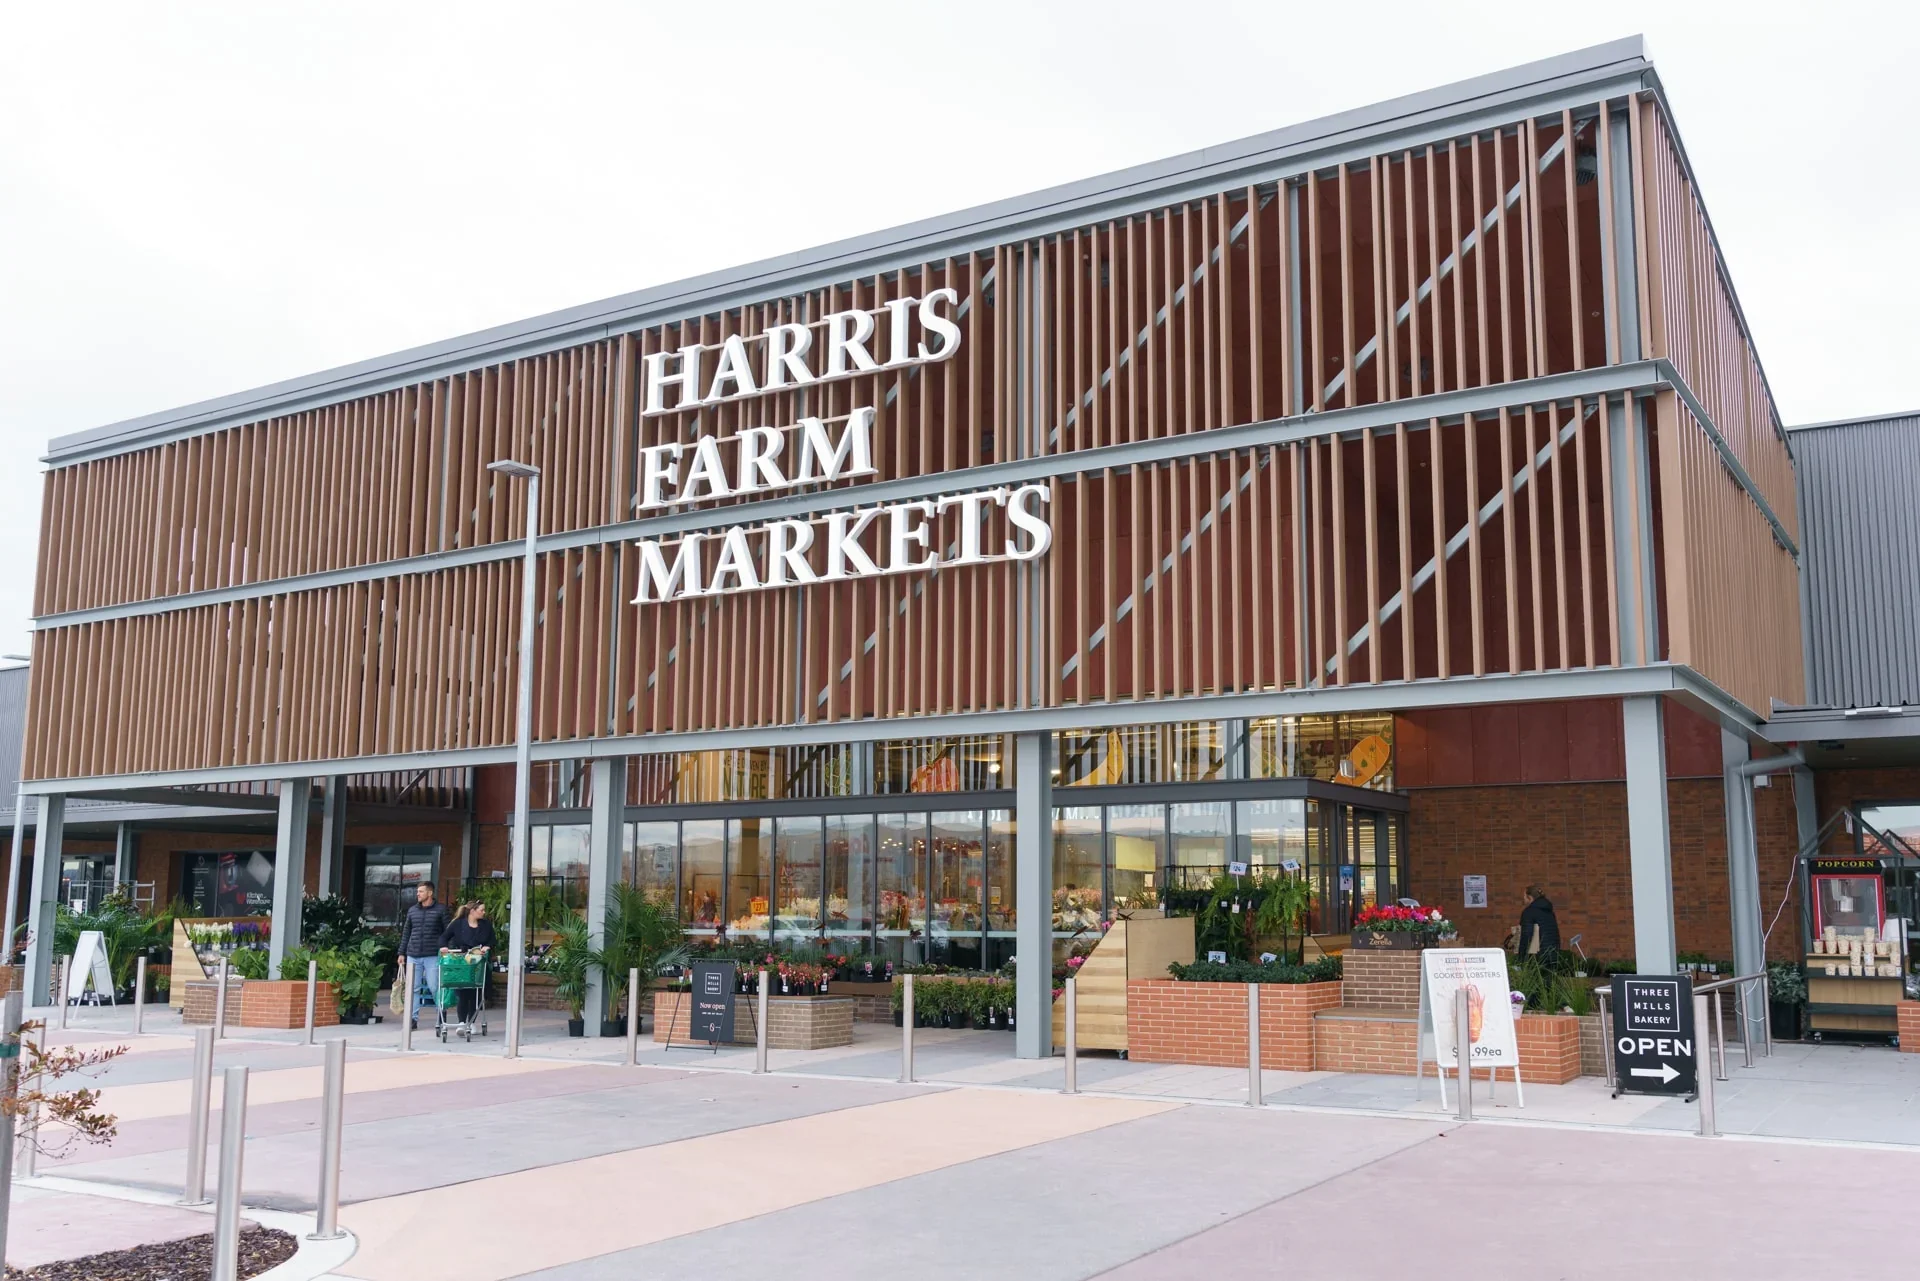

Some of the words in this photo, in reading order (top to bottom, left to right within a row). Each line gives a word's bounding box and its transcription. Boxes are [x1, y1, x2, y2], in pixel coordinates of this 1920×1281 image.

[641, 288, 961, 417] HARRIS
[638, 406, 878, 510] FARM
[630, 485, 1053, 605] MARKETS
[723, 767, 767, 800] NTRE
[1368, 937, 1393, 946] Zerella
[1466, 971, 1501, 979] LOBSTERS
[1633, 988, 1670, 997] THREE
[1633, 1002, 1671, 1010] MILLS
[1634, 1015, 1671, 1024] BAKERY
[1618, 1037, 1692, 1056] OPEN
